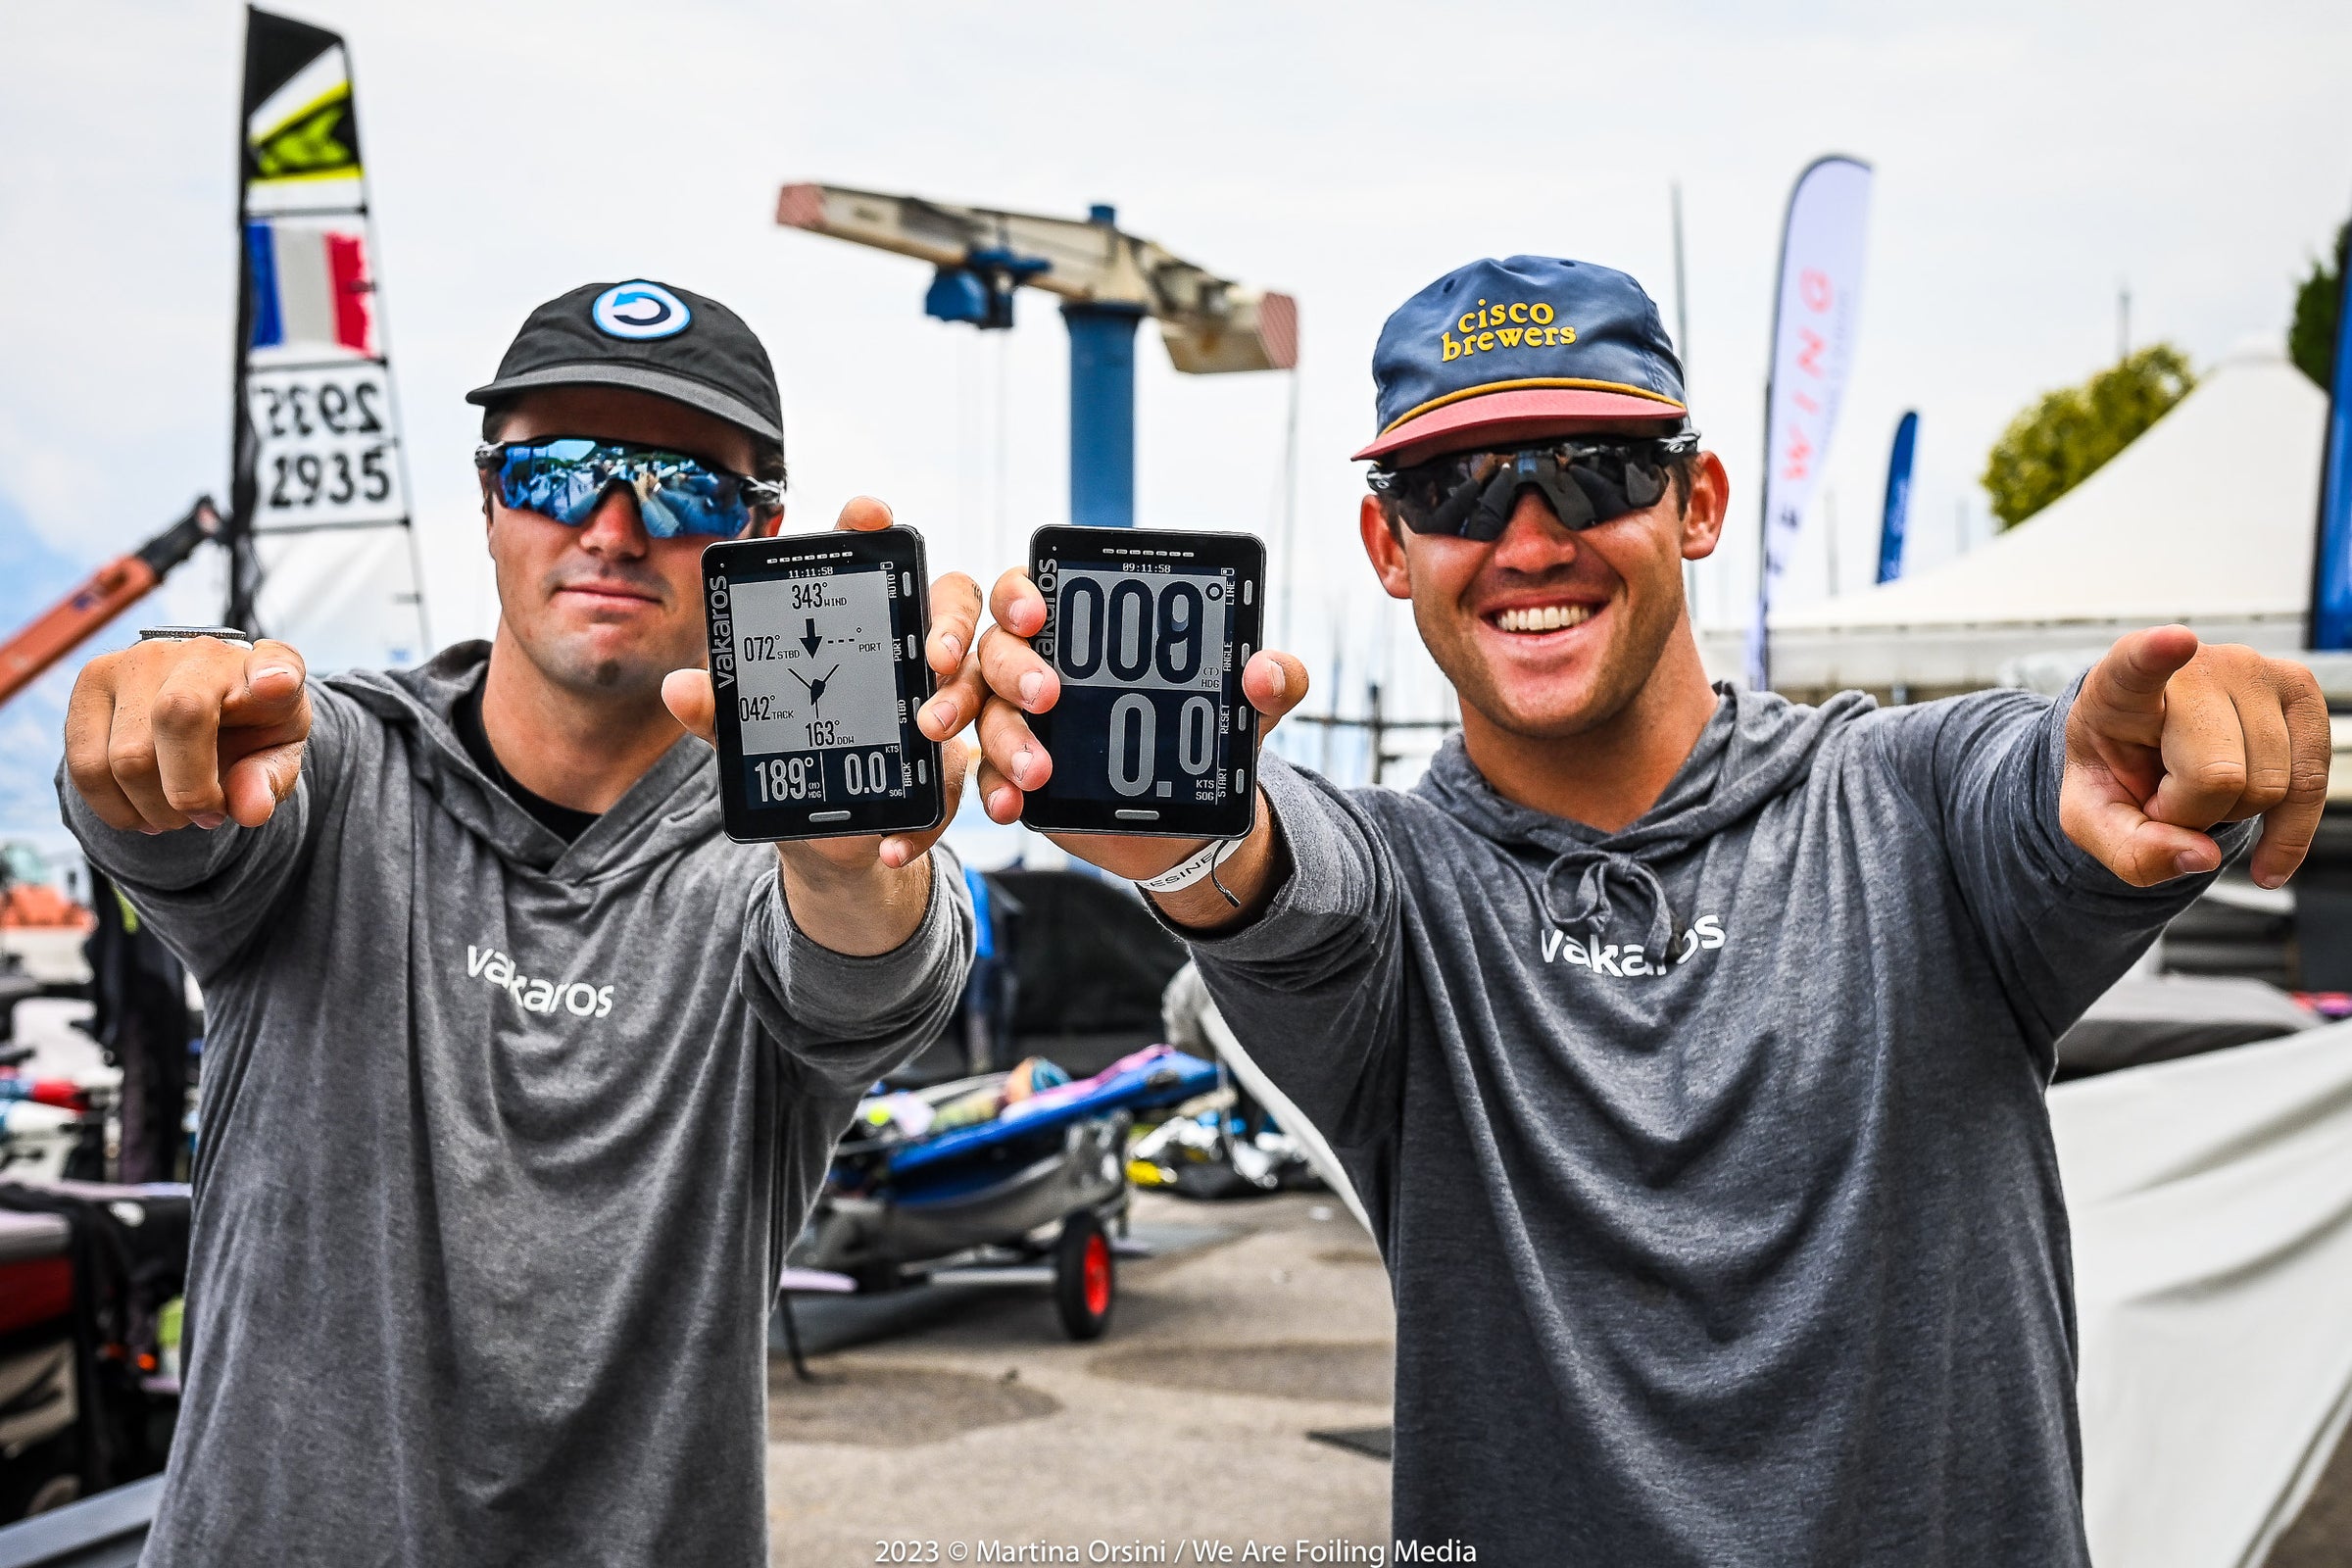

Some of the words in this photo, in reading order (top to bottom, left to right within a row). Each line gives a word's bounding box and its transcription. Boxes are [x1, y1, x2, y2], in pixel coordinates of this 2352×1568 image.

[1457, 298, 1554, 333] cisco
[1441, 326, 1577, 363] brewers
[270, 448, 391, 509] 2935
[788, 566, 833, 579] 11:11:58
[1122, 563, 1171, 573] 09:11:58
[888, 573, 898, 599] AUTO
[1226, 580, 1236, 606] LINE
[823, 597, 848, 608] WIND
[710, 575, 735, 688] vakaros
[777, 649, 801, 660] STBD
[858, 643, 882, 653] PORT
[893, 637, 902, 662] PORT
[1223, 641, 1233, 671] ANGLE
[1200, 678, 1220, 688] HDG
[1202, 666, 1220, 676] (T)
[771, 710, 794, 720] TACK
[899, 699, 907, 724] STBD
[1220, 704, 1230, 734] RESET
[837, 736, 855, 745] DDW
[885, 745, 900, 754] KTS
[1108, 693, 1214, 798] 0.0
[844, 752, 887, 795] 0.0
[903, 761, 912, 787] BACK
[1196, 779, 1215, 789] KTS
[1217, 767, 1227, 798] START
[889, 788, 903, 798] SOG
[1196, 791, 1214, 801] SOG
[1145, 852, 1213, 888] ESINE
[466, 944, 615, 1018] vakaros
